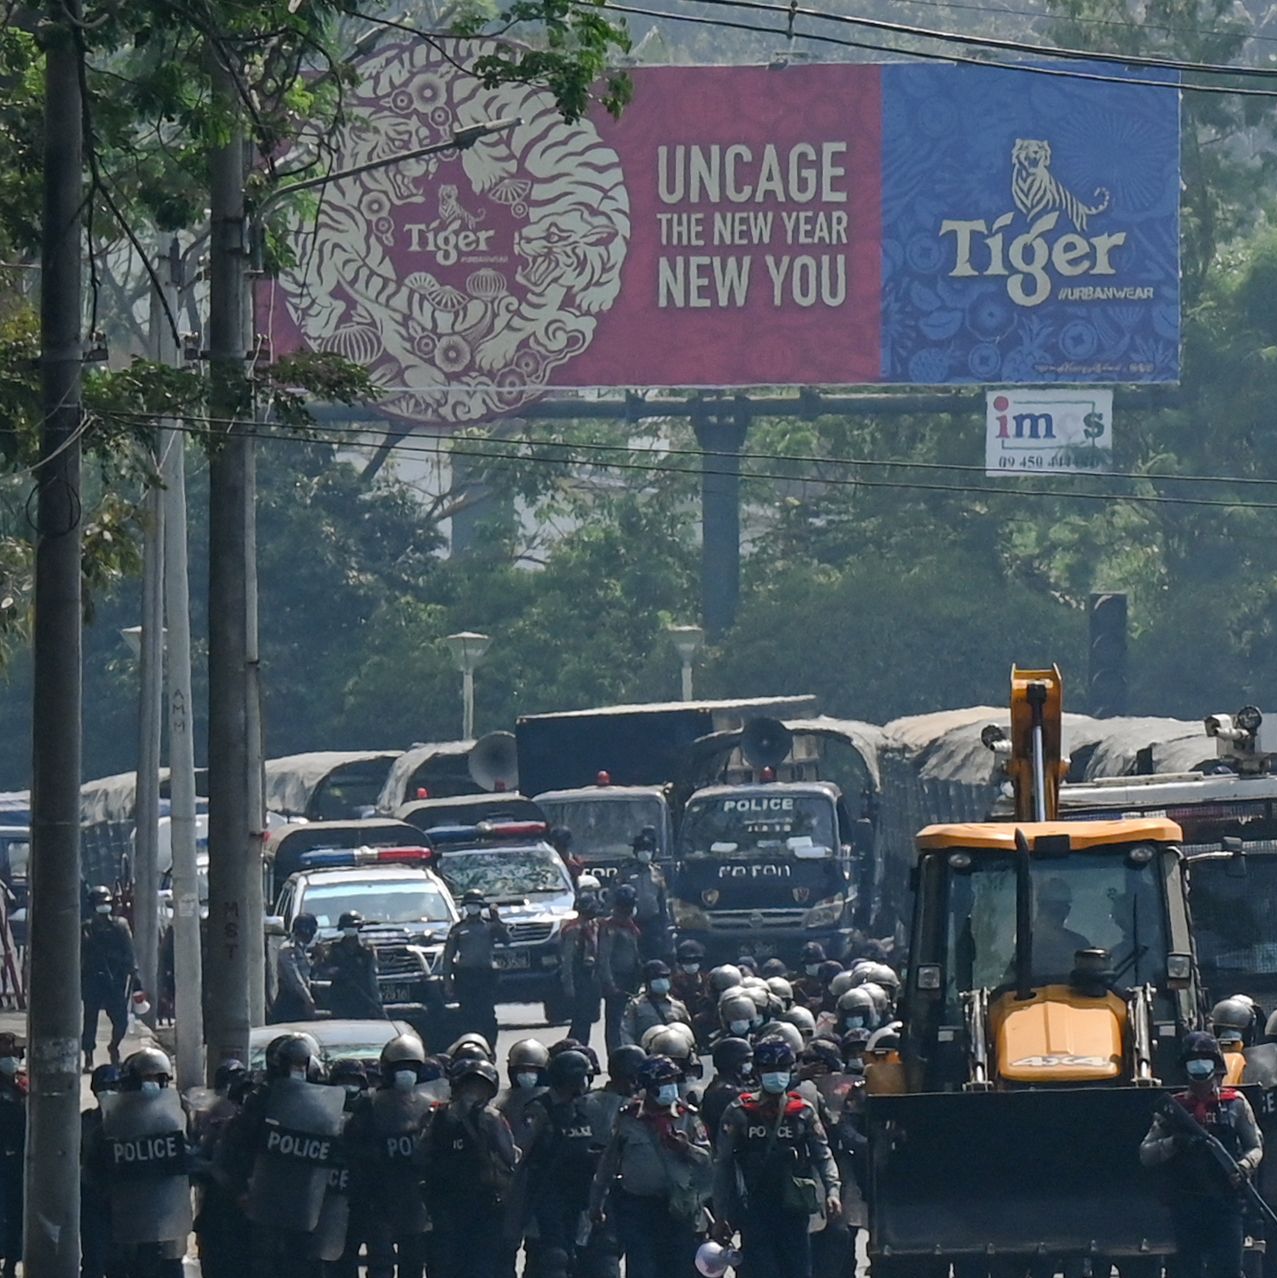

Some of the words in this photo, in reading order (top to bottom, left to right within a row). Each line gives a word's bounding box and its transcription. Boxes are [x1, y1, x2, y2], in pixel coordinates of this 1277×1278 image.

[657, 141, 848, 204] UNCAGE
[403, 219, 496, 266] Tiger
[656, 212, 704, 246] THE
[713, 211, 773, 245] NEW
[781, 210, 849, 245] YEAR
[939, 211, 1127, 307] Tiger
[658, 255, 752, 308] NEW
[764, 253, 846, 307] YOU
[723, 798, 794, 812] POLICE
[113, 1137, 177, 1163] POLICE
[267, 1130, 331, 1160] POLICE
[748, 1126, 793, 1138] POCE
